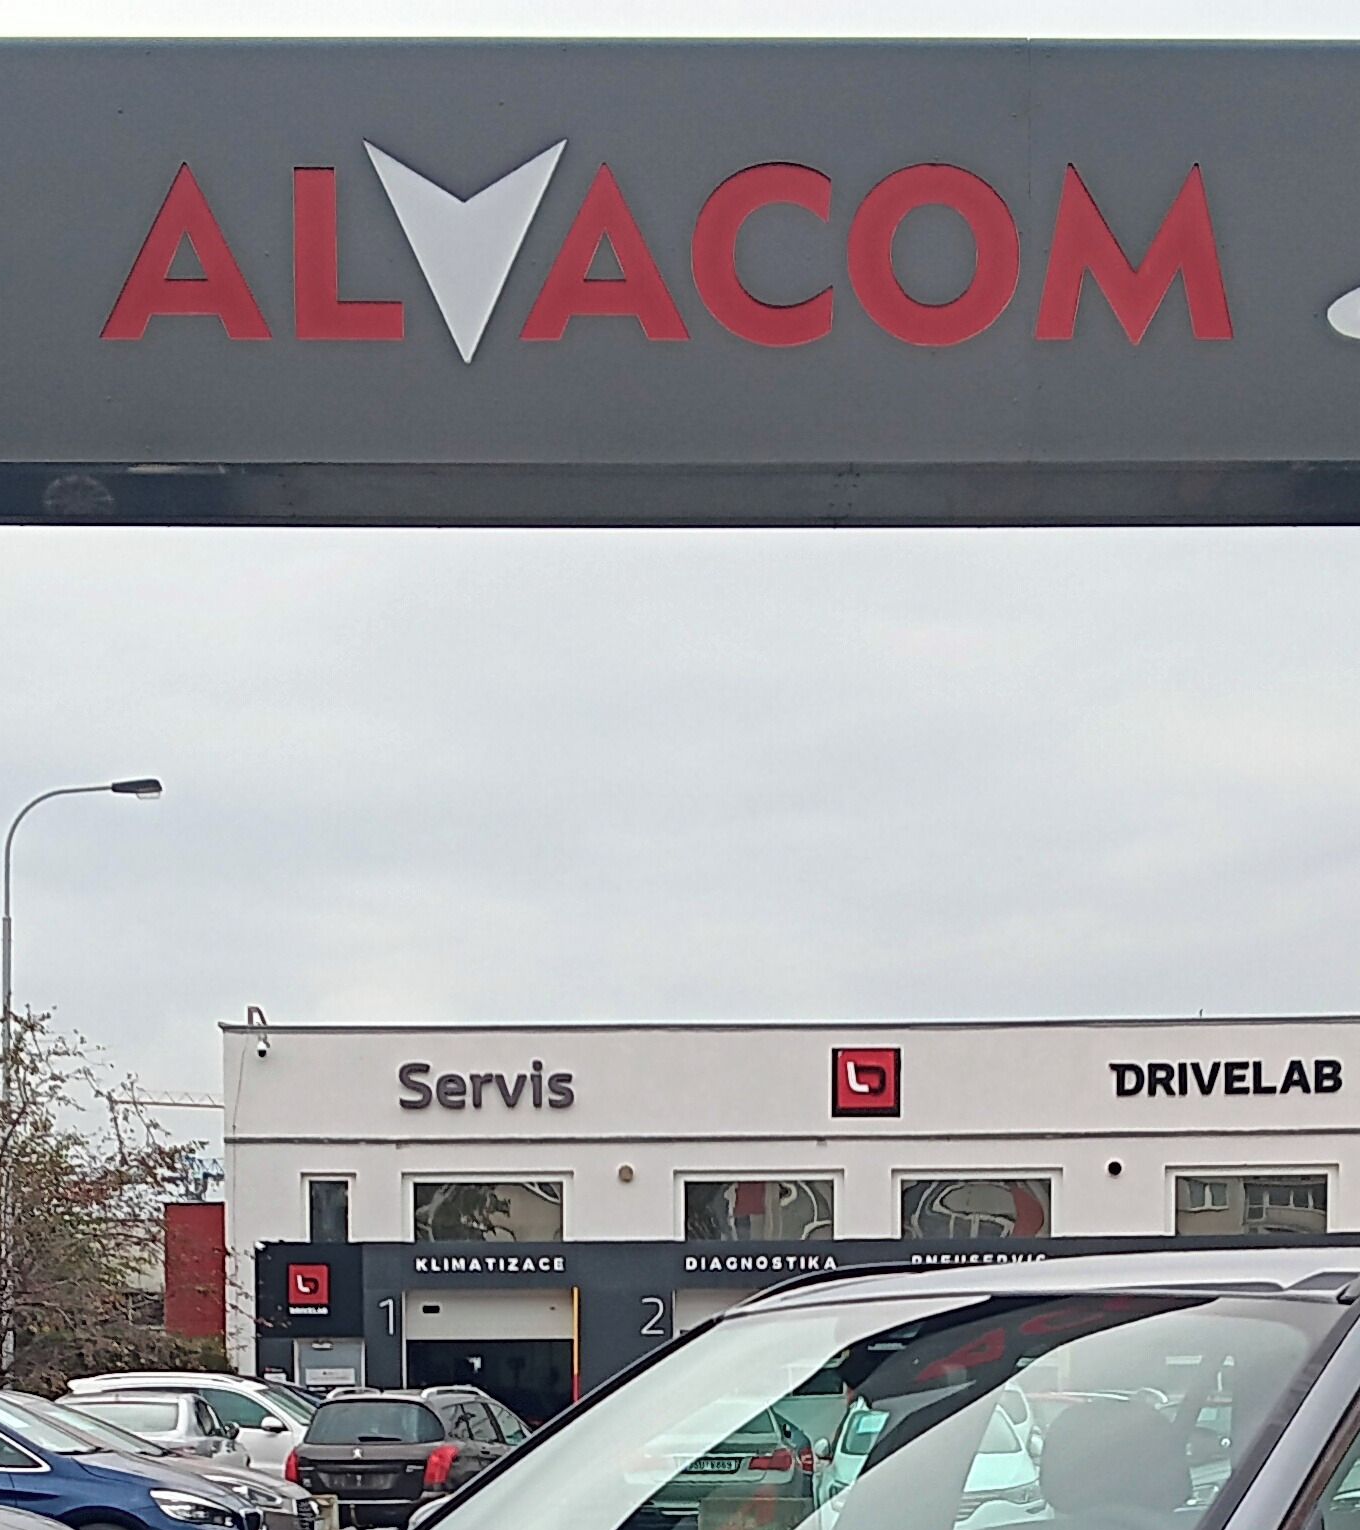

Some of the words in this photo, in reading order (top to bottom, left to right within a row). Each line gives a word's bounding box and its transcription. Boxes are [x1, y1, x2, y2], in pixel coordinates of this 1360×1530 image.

[99, 138, 1233, 364] ALVACOM
[398, 1060, 575, 1110] Servis
[1108, 1059, 1343, 1097] DRIVELAB
[415, 1257, 565, 1272] KLIMATIZACE
[685, 1256, 838, 1271] DIAGNOSTIKA
[378, 1298, 394, 1336] 1
[640, 1297, 665, 1335] 2
